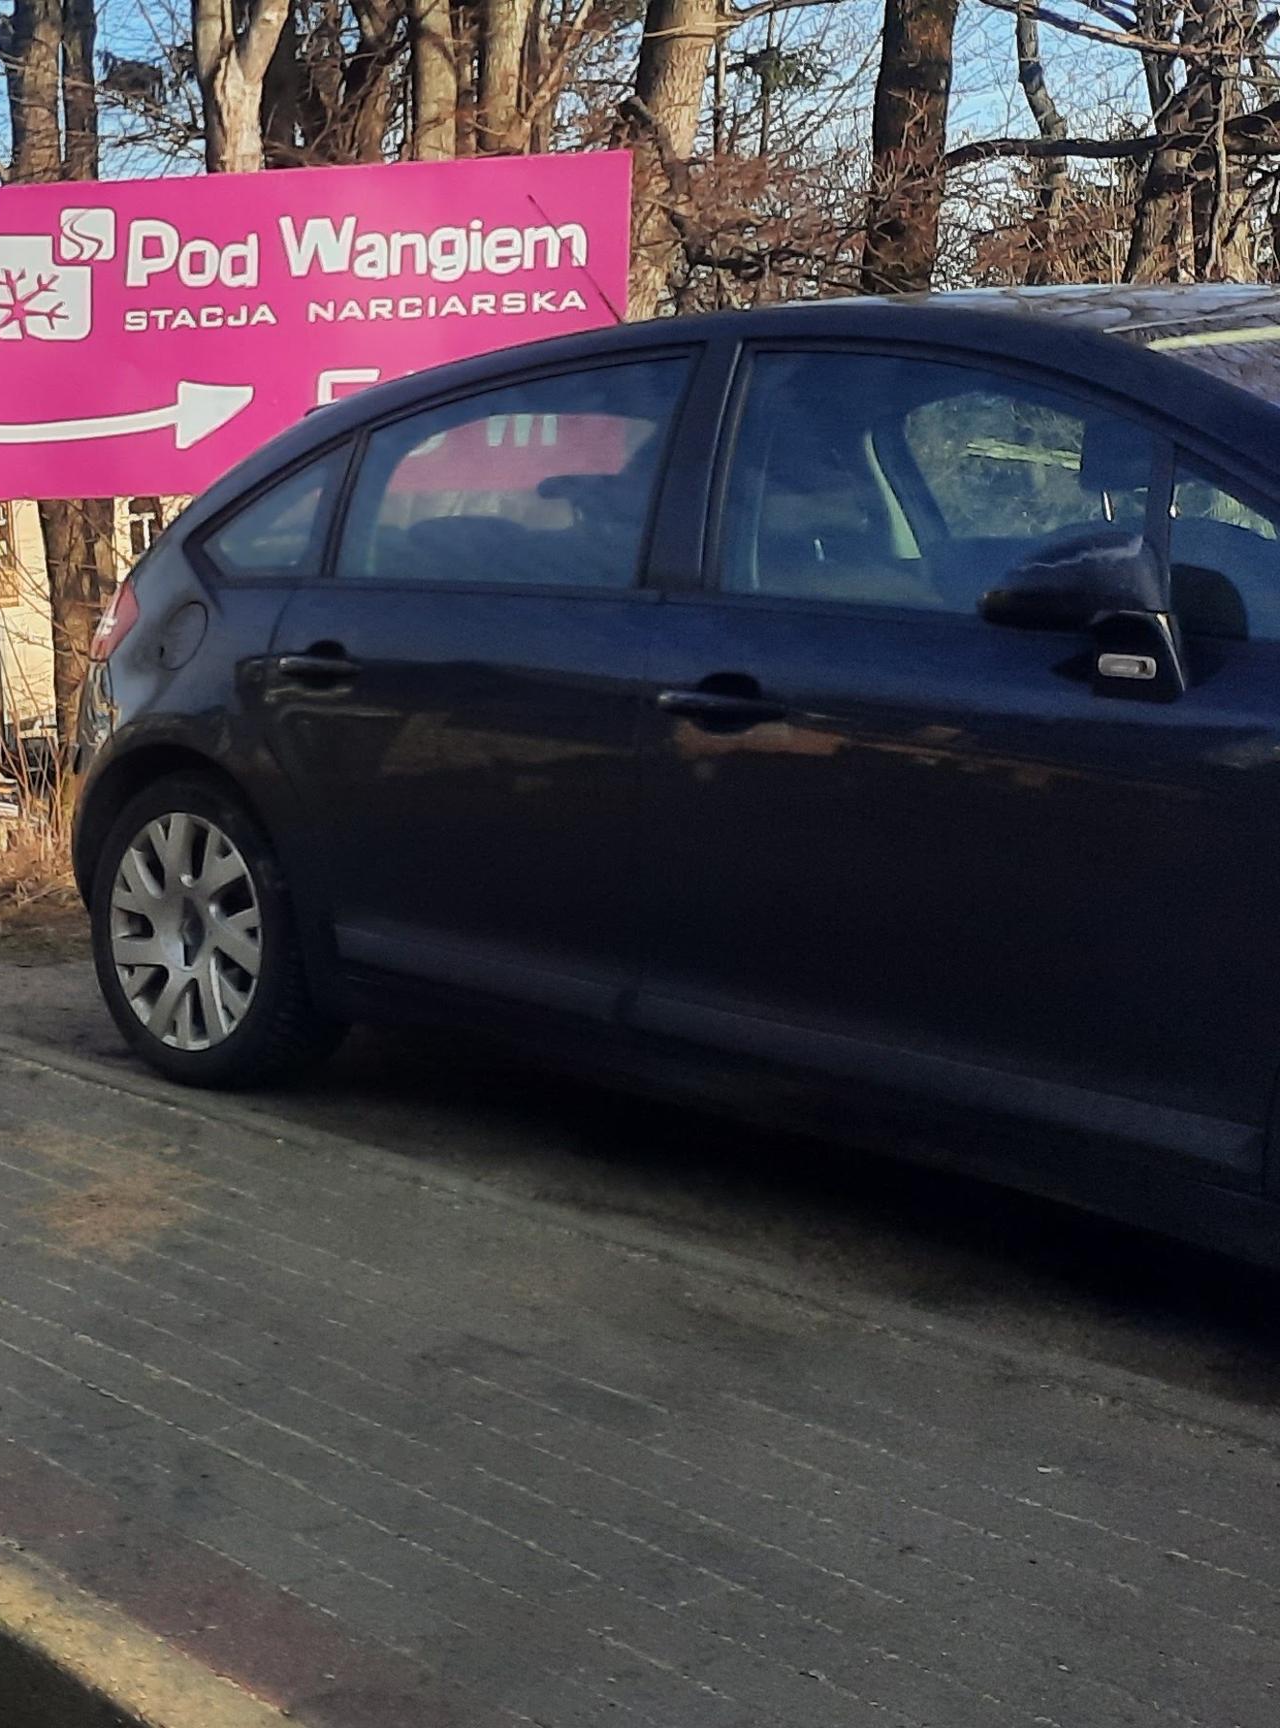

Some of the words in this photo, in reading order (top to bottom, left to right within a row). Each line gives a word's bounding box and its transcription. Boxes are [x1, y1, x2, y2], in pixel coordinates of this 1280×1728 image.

[125, 218, 259, 288] Pod
[278, 215, 588, 283] Wangiem
[124, 302, 278, 332] STACJA
[307, 289, 587, 323] NARCIARSKA
